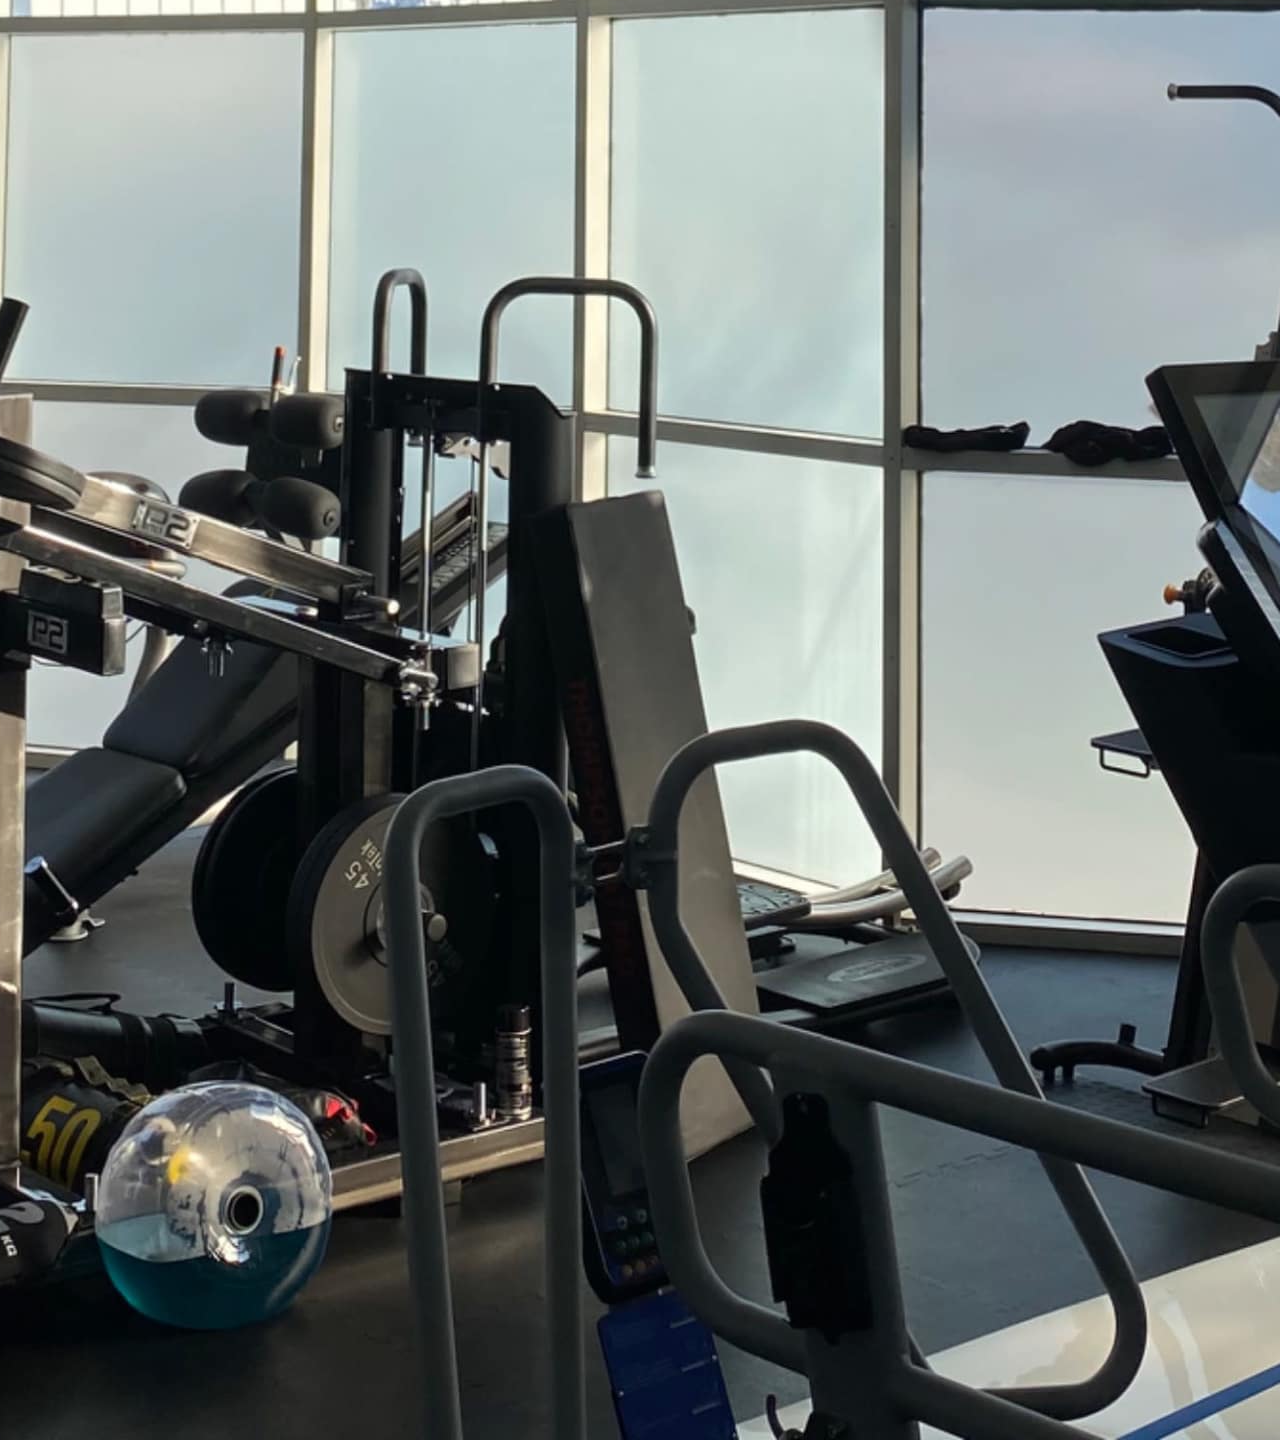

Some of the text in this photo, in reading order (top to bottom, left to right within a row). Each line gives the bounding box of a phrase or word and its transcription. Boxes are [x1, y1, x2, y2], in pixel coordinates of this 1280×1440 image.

[32, 615, 63, 650] P2
[344, 861, 369, 889] 45
[20, 1094, 102, 1190] 50
